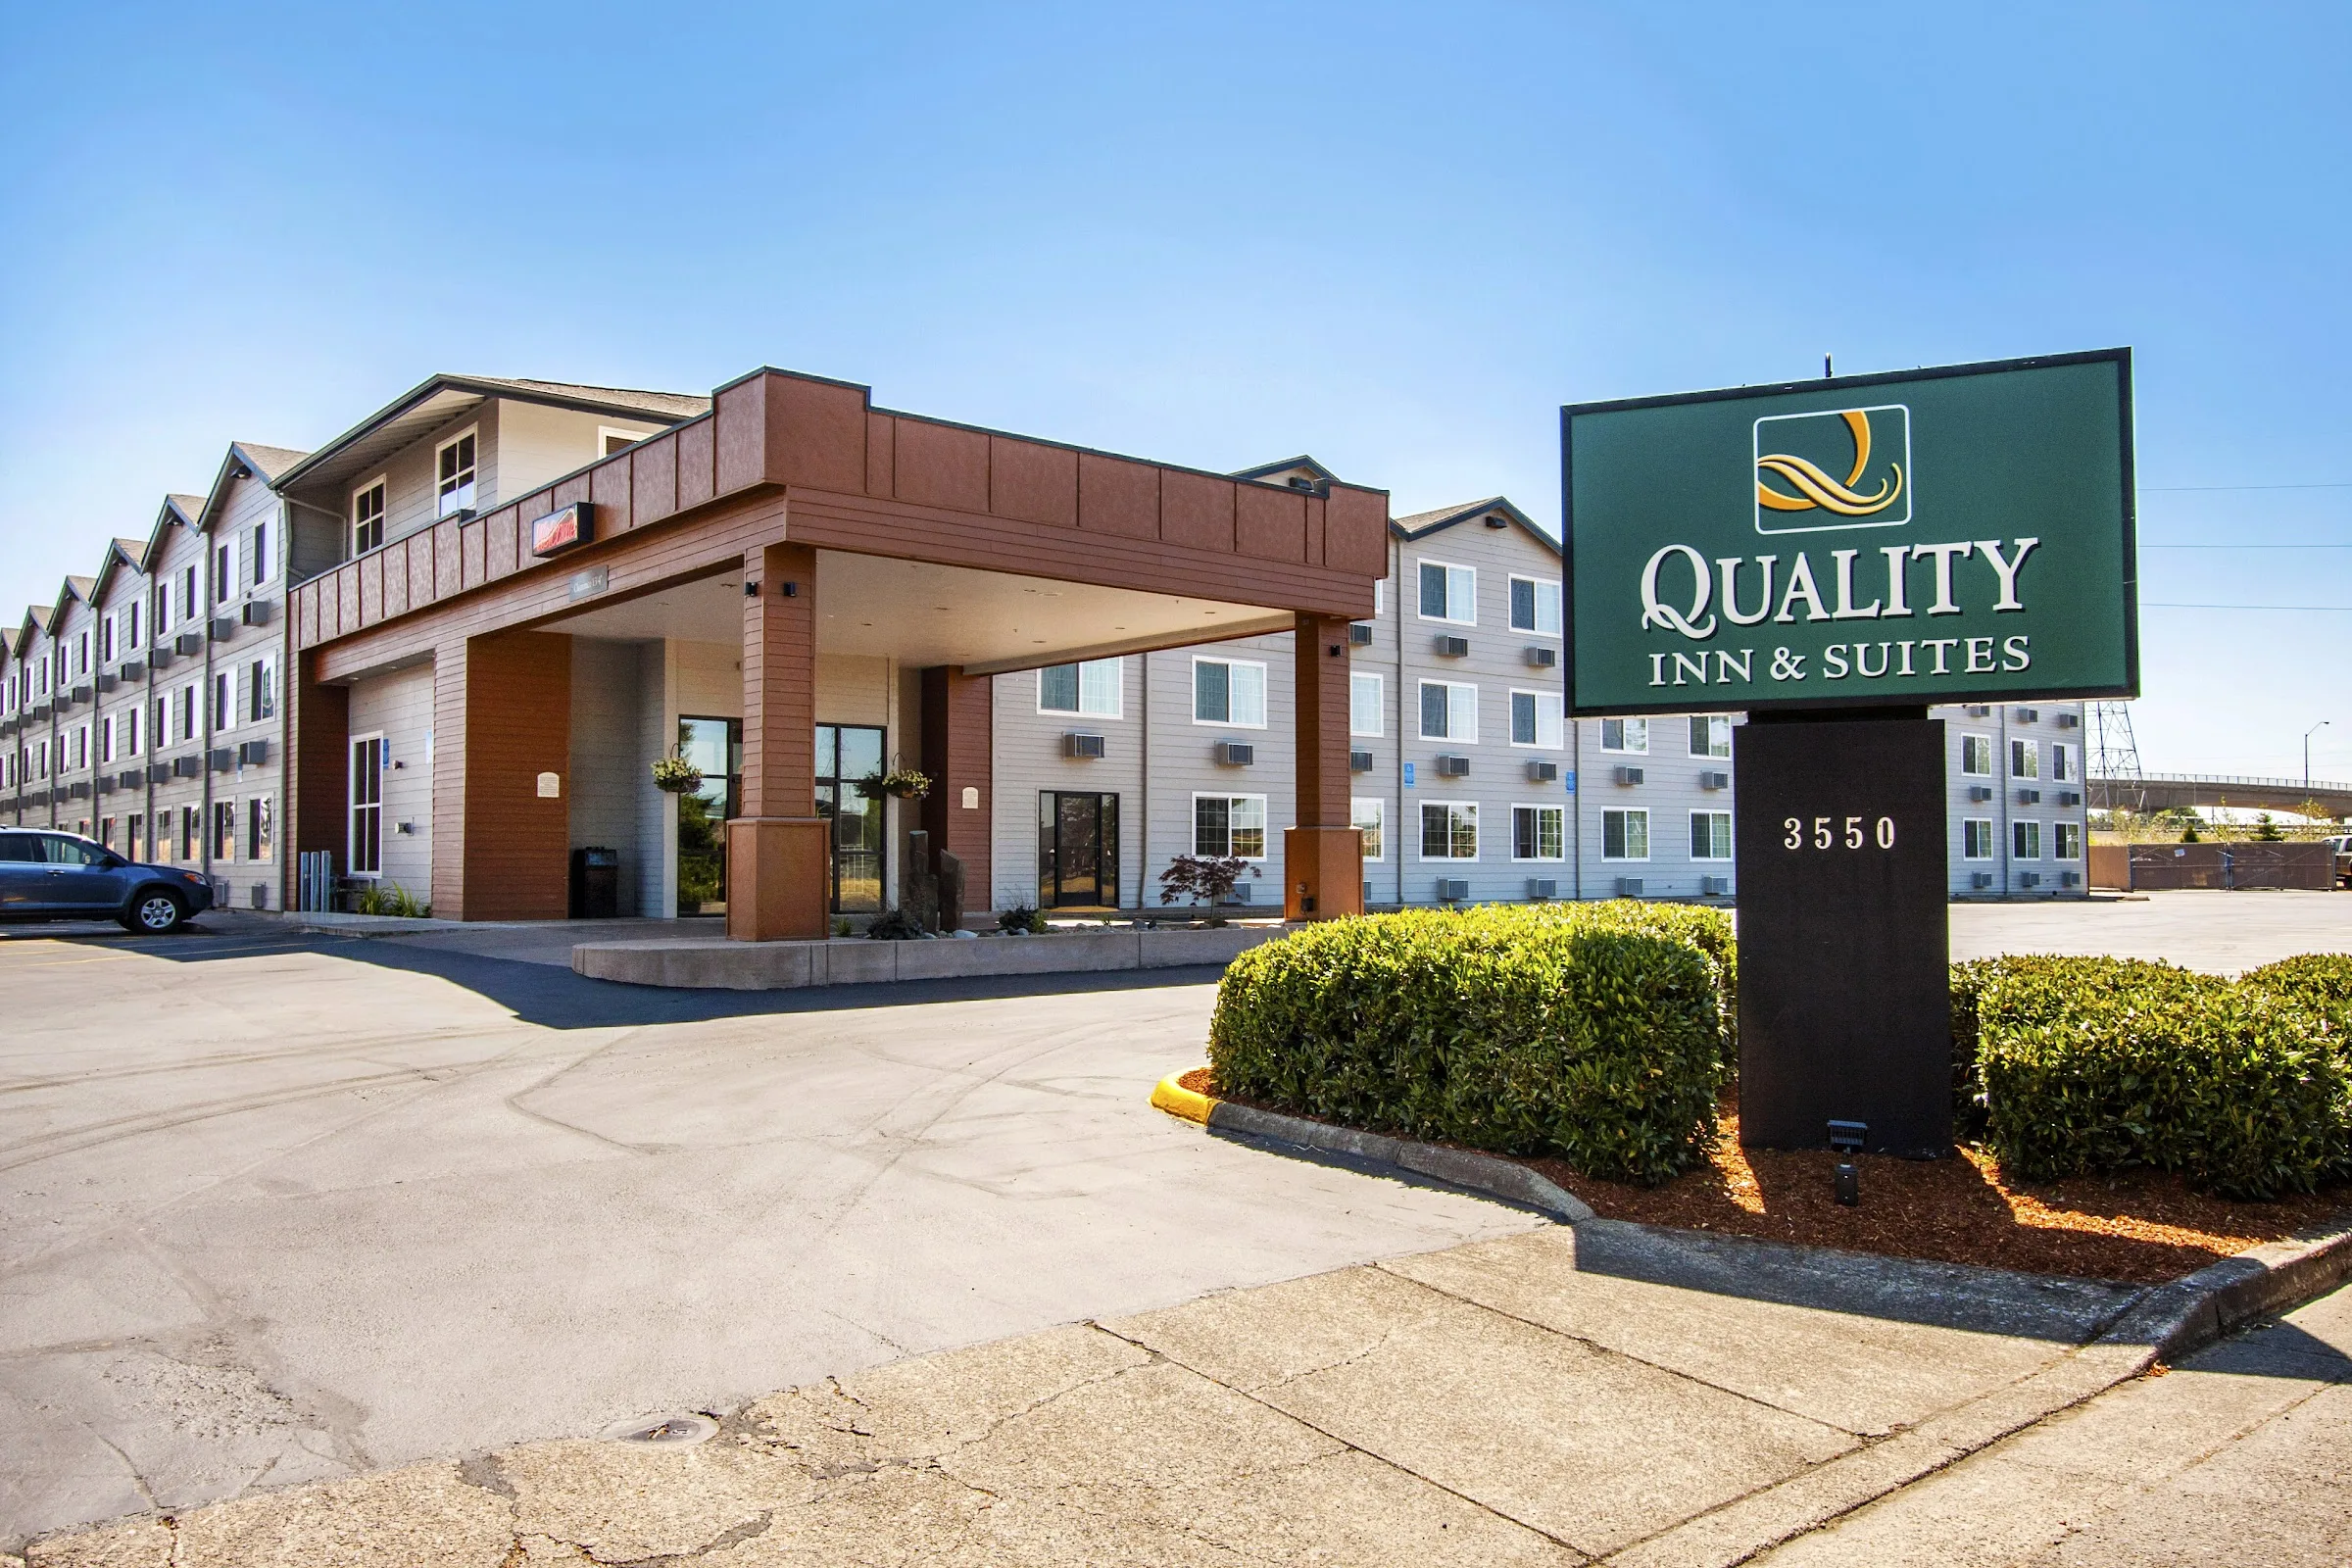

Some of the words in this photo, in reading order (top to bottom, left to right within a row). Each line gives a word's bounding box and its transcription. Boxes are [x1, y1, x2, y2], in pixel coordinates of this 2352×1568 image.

[1641, 537, 2037, 639] QUALITY
[1648, 649, 1753, 686] INN
[1770, 647, 1806, 680] &
[1823, 635, 2030, 679] SUITES
[1784, 816, 1894, 850] 3550
